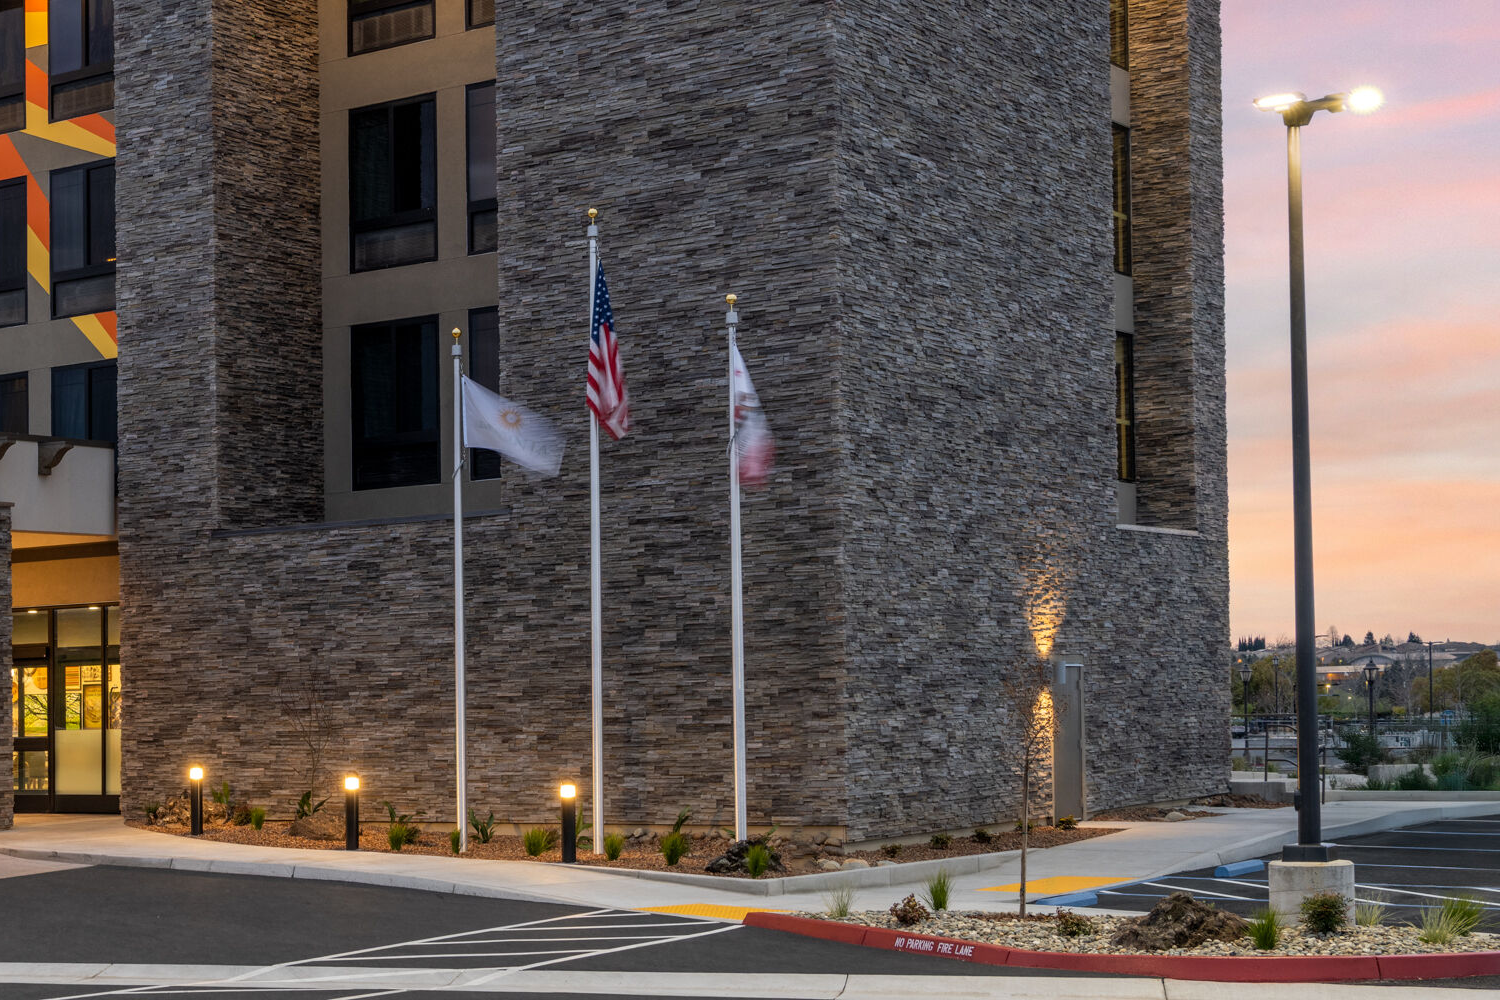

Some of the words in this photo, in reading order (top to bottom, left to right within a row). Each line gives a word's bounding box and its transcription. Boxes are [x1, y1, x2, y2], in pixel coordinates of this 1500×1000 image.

[894, 937, 905, 948] NO
[905, 939, 935, 952] PARKING
[936, 942, 954, 954] FIRE
[955, 944, 975, 957] LANE
